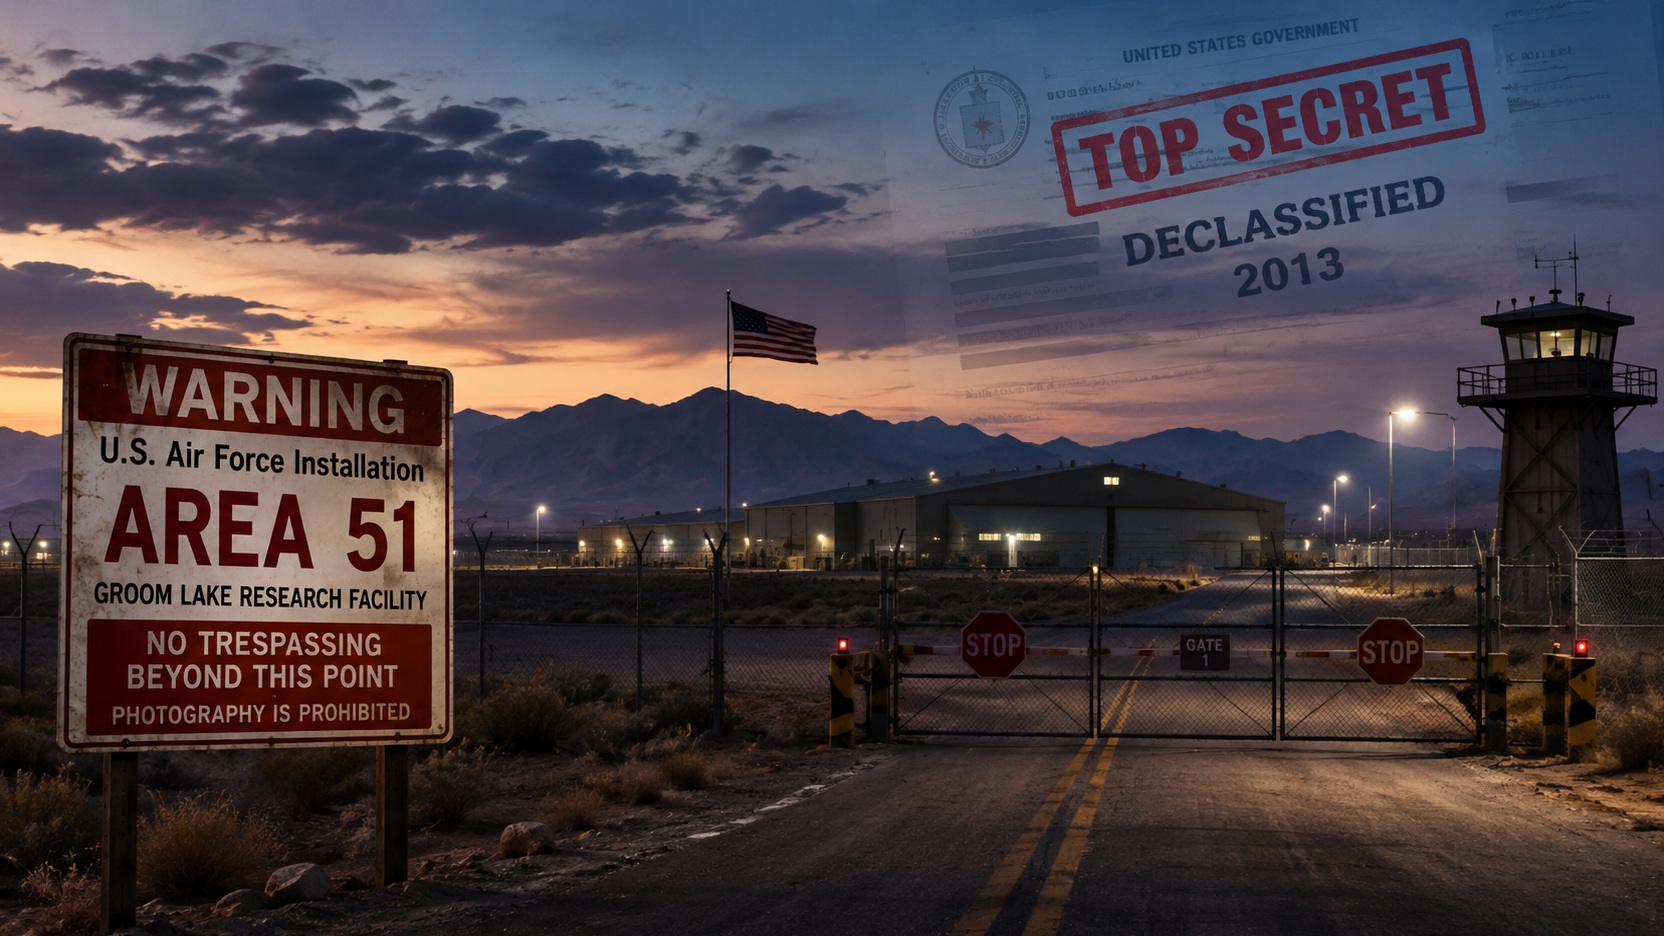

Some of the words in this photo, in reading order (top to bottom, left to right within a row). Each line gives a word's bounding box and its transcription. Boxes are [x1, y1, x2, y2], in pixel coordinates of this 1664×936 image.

[122, 362, 405, 435] WARNING
[100, 435, 155, 466] U.S.
[166, 440, 204, 469] Air
[215, 444, 284, 474] Force
[295, 449, 424, 482] Installation
[104, 485, 314, 569] AREA
[347, 497, 415, 573] 51
[94, 582, 172, 606] GROOM
[181, 584, 232, 607] LAKE
[240, 586, 342, 609] RESEARCH
[350, 589, 427, 610] FACILITY
[147, 630, 187, 656] NO
[198, 631, 381, 657] TRESPASSING
[966, 633, 1021, 657] STOP
[1186, 638, 1224, 653] GATE
[1363, 640, 1419, 665] STOP
[1202, 654, 1209, 667] 1
[127, 664, 241, 690] BEYOND
[253, 664, 312, 689] THIS
[324, 664, 398, 689] POINT
[112, 704, 265, 726] PHOTOGRAPHY
[273, 704, 290, 723] IS
[299, 703, 411, 722] PROHIBITED
